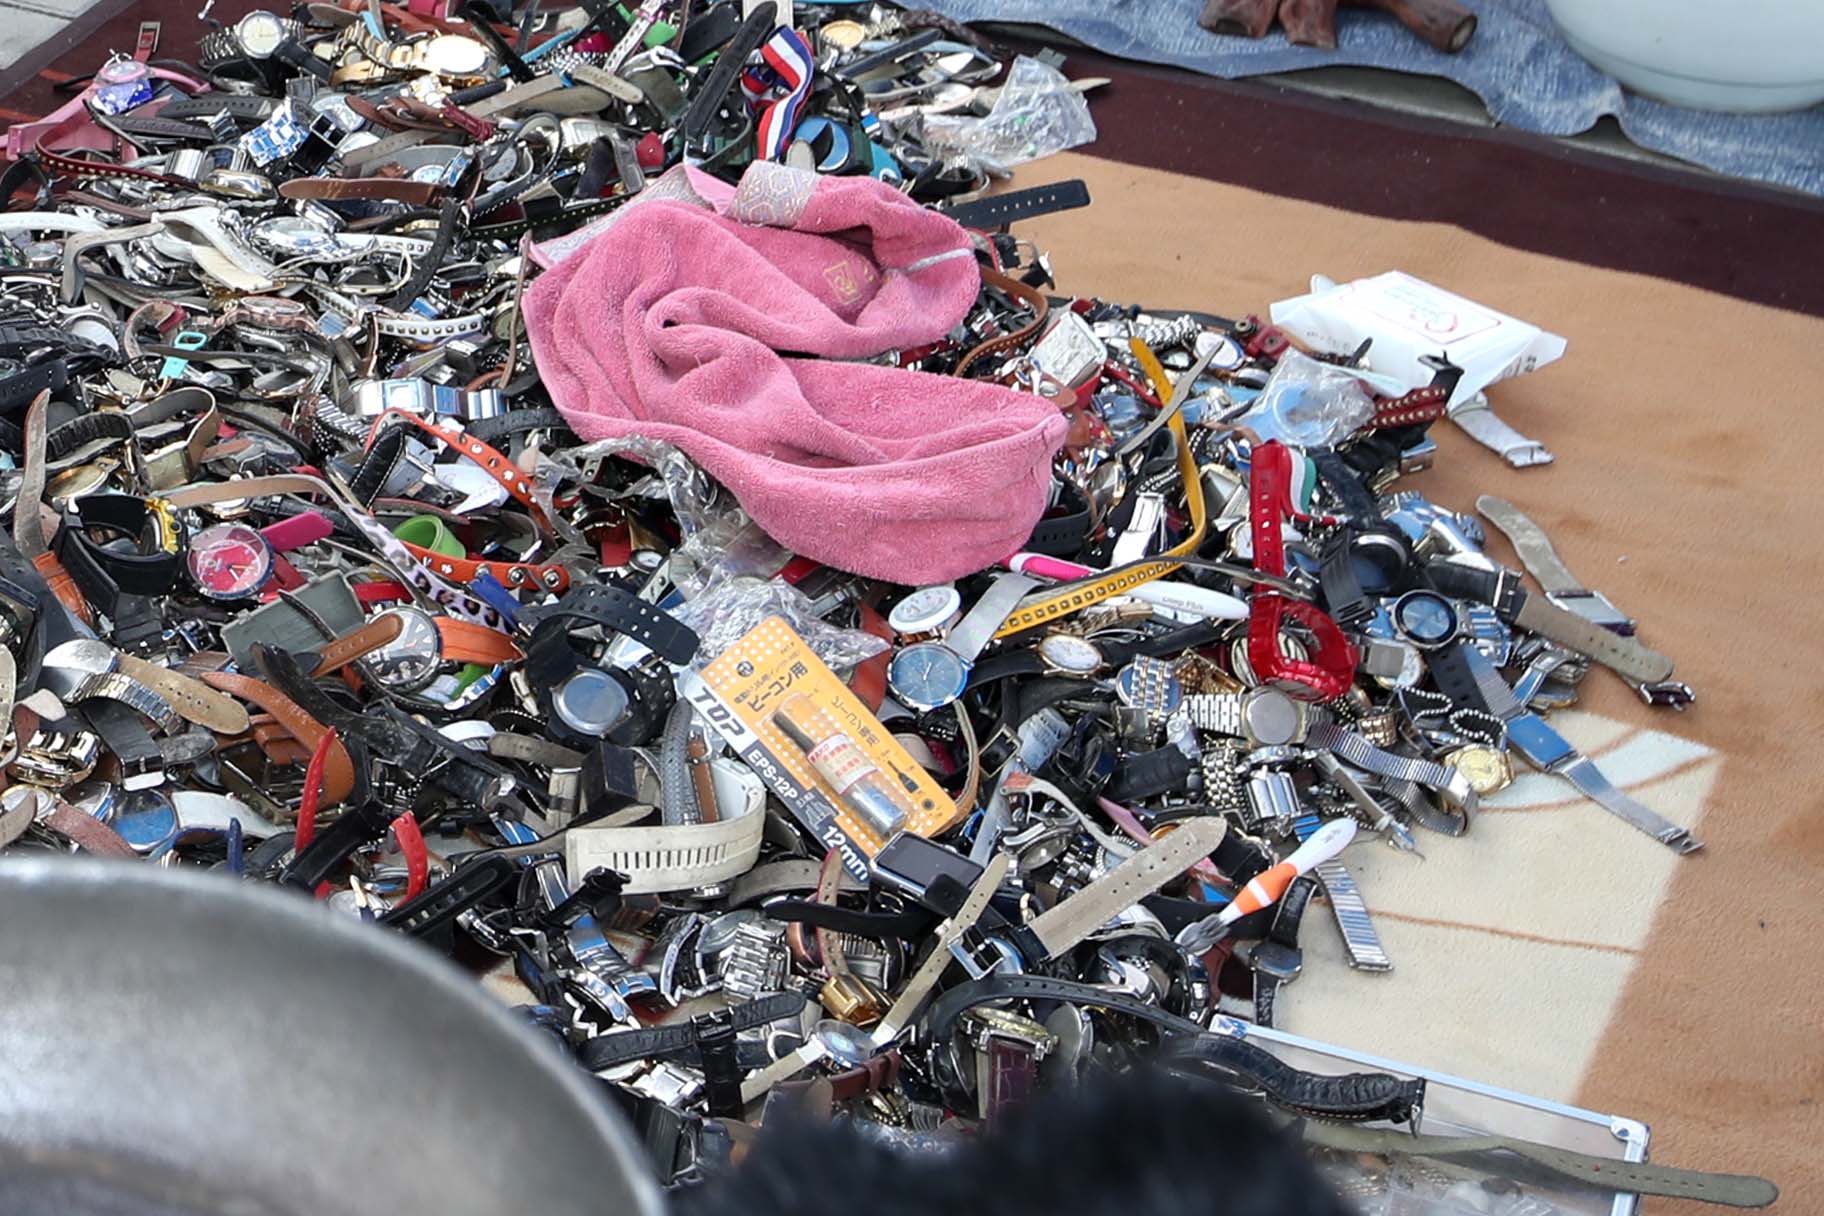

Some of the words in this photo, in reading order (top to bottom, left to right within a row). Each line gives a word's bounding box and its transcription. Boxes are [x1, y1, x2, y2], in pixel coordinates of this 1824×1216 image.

[694, 686, 745, 736] TOP
[747, 661, 808, 712] ビーコン用
[748, 749, 798, 799] EPS-12P
[822, 825, 869, 881] 12mm
